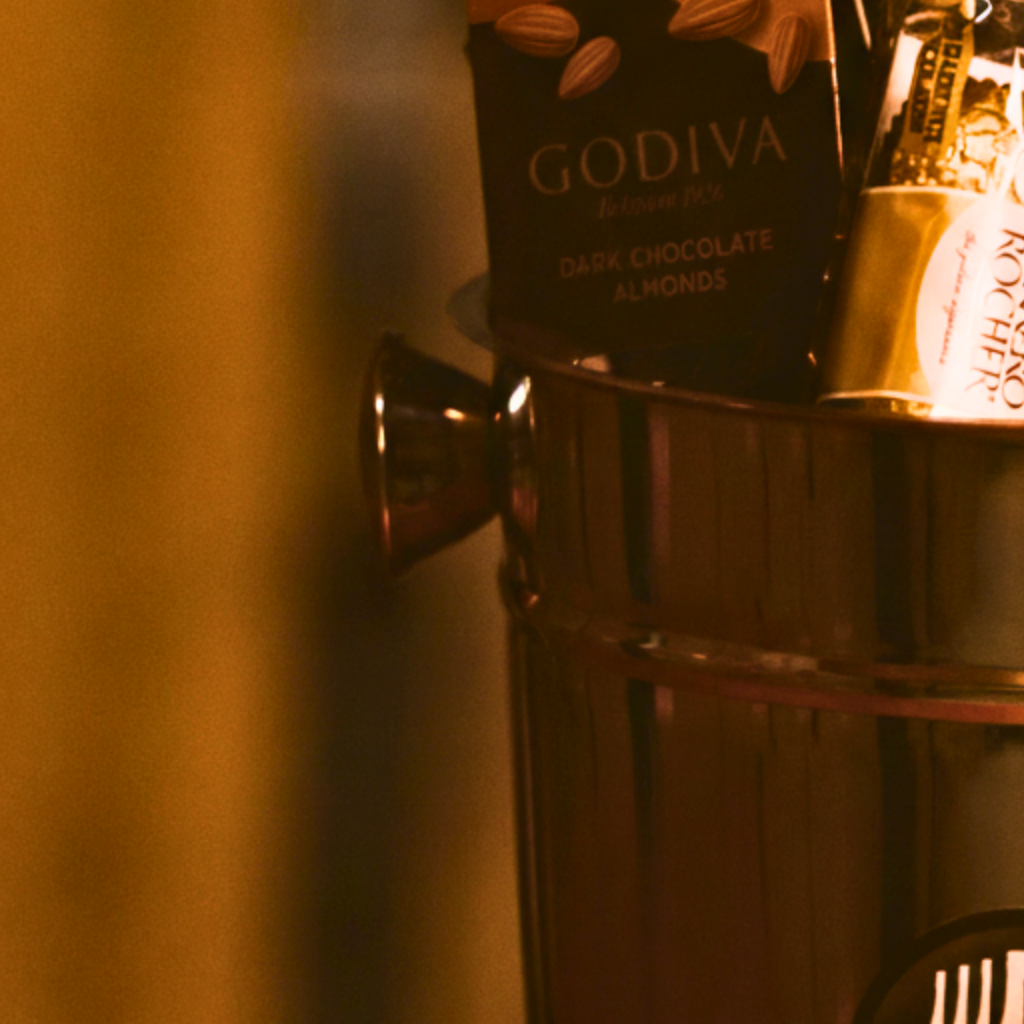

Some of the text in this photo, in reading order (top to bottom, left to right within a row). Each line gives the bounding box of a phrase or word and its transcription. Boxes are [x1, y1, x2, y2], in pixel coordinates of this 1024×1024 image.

[528, 114, 788, 196] GODIVA
[560, 229, 774, 278] DARK CHOCOLATE
[613, 268, 728, 302] ALMONDS
